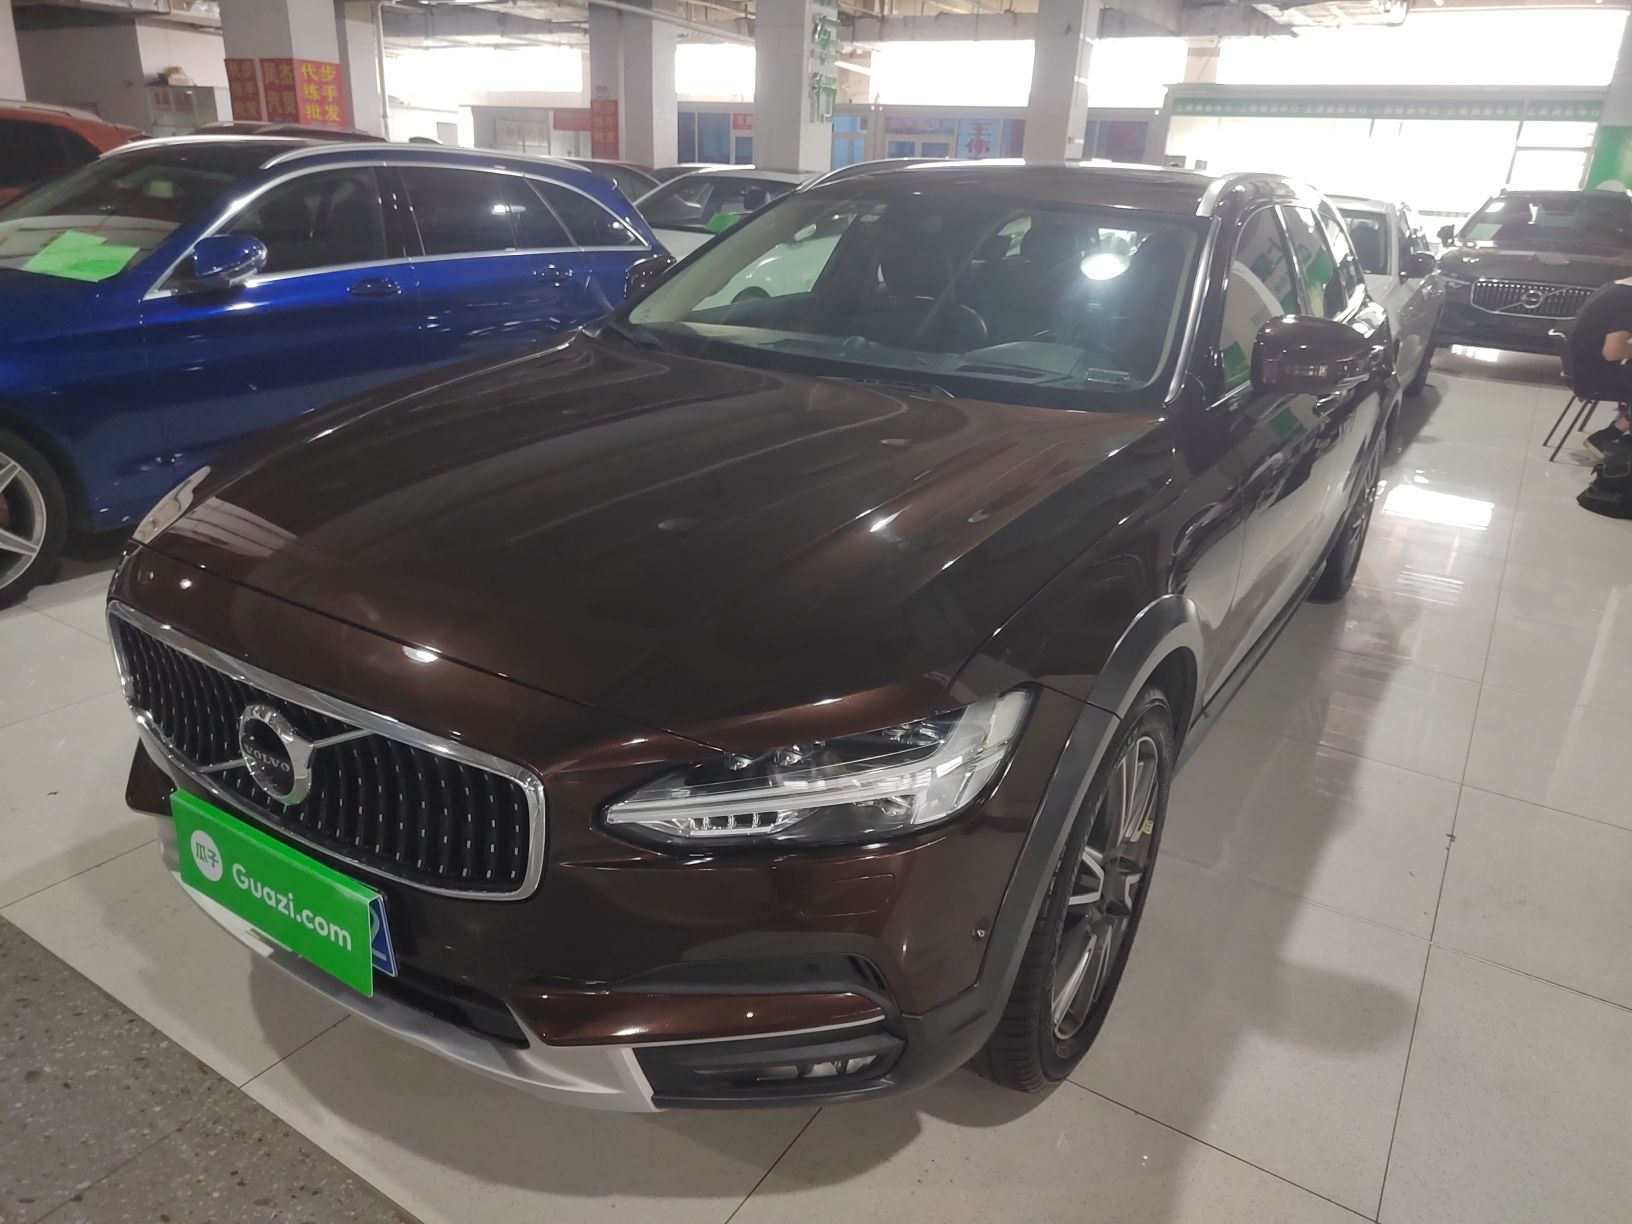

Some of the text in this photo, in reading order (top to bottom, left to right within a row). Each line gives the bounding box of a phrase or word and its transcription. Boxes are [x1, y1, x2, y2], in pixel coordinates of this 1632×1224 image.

[301, 62, 337, 81] 代步
[303, 83, 339, 102] 练手
[304, 102, 341, 121] 批发
[243, 743, 290, 772] VOLVO
[195, 842, 219, 869] 瓜子
[232, 863, 352, 952] Guazi.com
